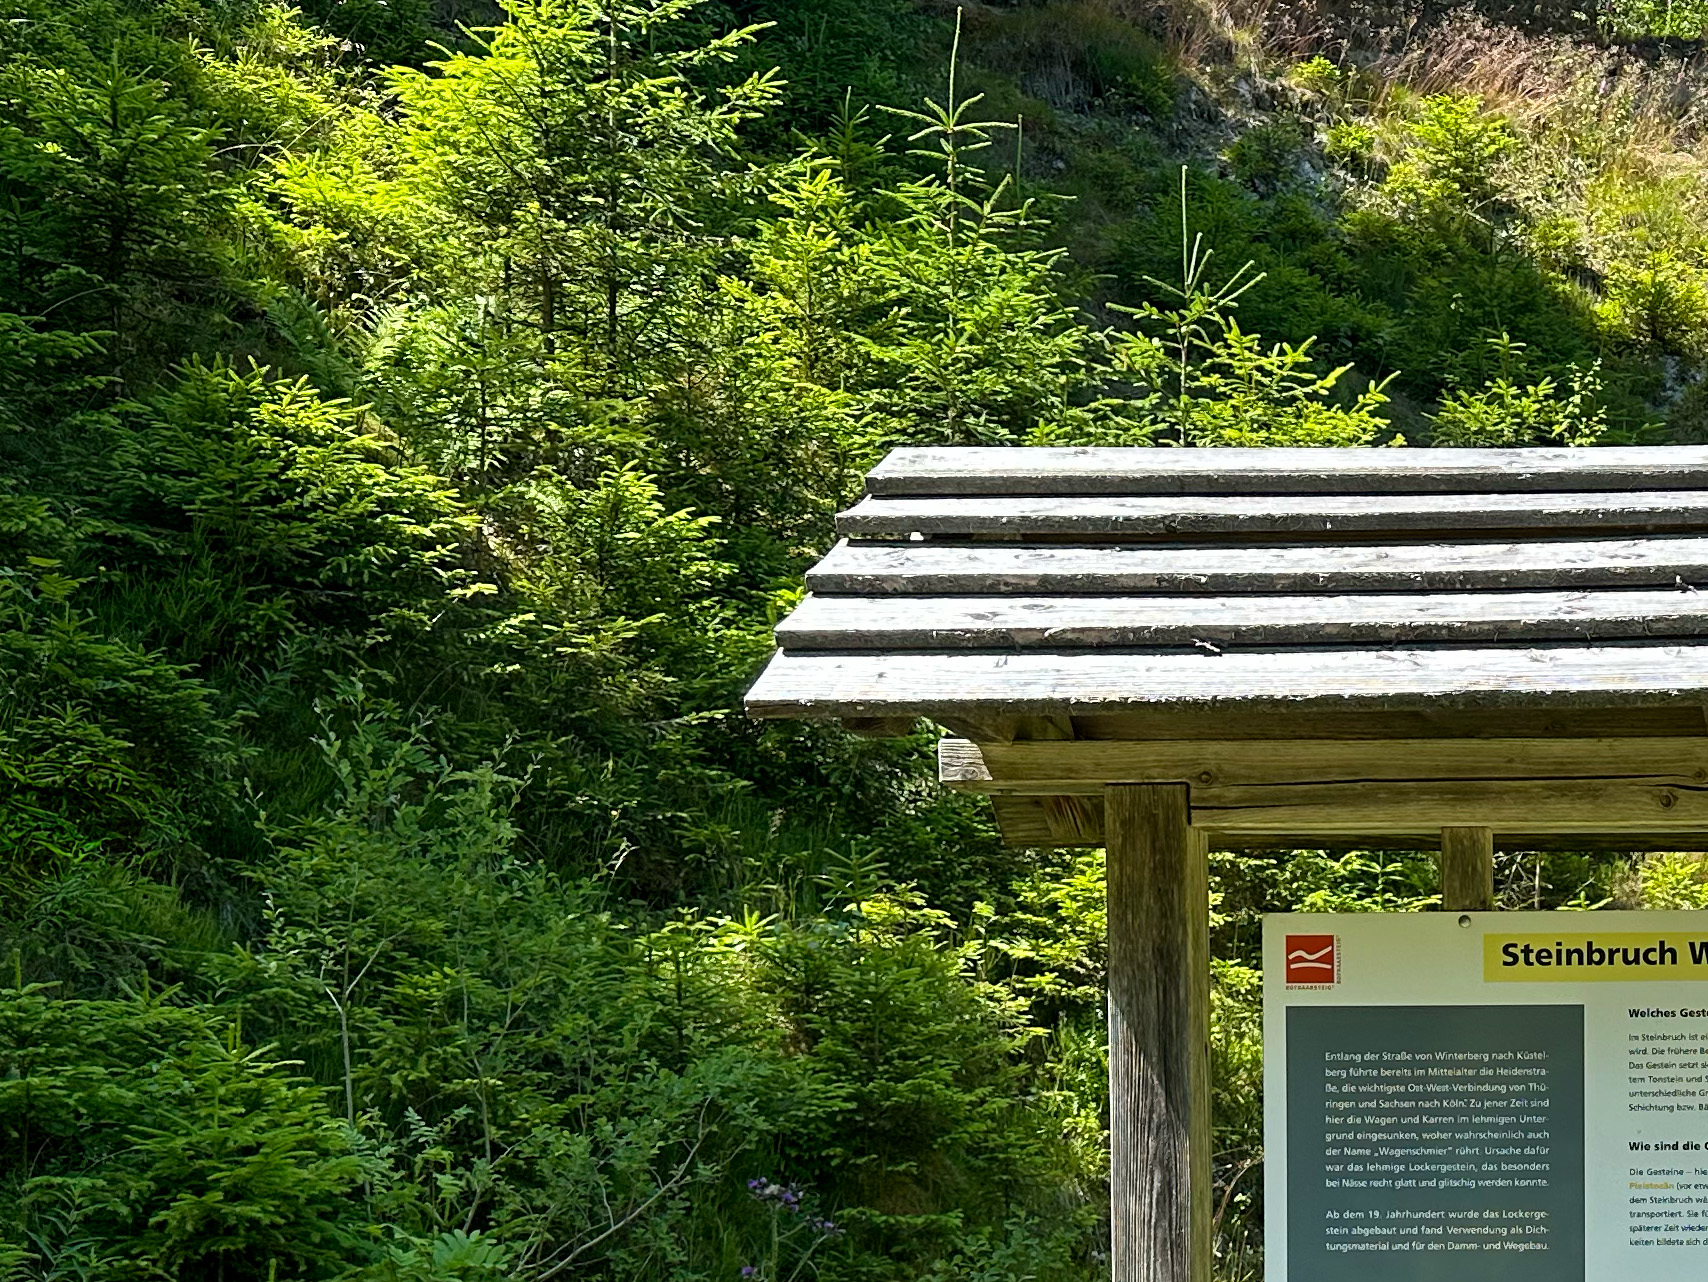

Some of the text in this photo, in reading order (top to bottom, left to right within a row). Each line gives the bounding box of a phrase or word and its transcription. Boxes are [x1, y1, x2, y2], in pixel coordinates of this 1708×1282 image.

[1503, 941, 1677, 966] Steinbruch
[1629, 1008, 1676, 1017] Welches
[1326, 1052, 1361, 1062] Entlang
[1364, 1052, 1379, 1060] der
[1383, 1052, 1412, 1060] Straße
[1435, 1052, 1489, 1062] Winterberg
[1492, 1051, 1514, 1059] nach
[1517, 1051, 1550, 1059] Küstel-
[1325, 1068, 1346, 1078] berg
[1349, 1068, 1378, 1076] führte
[1381, 1068, 1411, 1076] bereits
[1480, 1067, 1493, 1075] die
[1497, 1067, 1550, 1075] Heidenstra-
[1342, 1084, 1356, 1092] die
[1359, 1084, 1405, 1094] wichtigste
[1408, 1083, 1506, 1093] Ost-West-Verbindung
[1529, 1083, 1550, 1091] Thü-
[1326, 1100, 1355, 1110] ringen
[1359, 1099, 1376, 1108] und
[1379, 1099, 1415, 1108] Sachsen
[1418, 1099, 1440, 1107] nach
[1470, 1099, 1481, 1107] Zu
[1484, 1100, 1507, 1109] jener
[1510, 1099, 1528, 1107] Zeit
[1531, 1099, 1549, 1107] sind
[1326, 1116, 1344, 1124] hier
[1347, 1115, 1361, 1124] die
[1364, 1116, 1397, 1126] Wagen
[1401, 1115, 1419, 1123] und
[1423, 1115, 1454, 1123] Karren
[1472, 1114, 1516, 1125] lehmigen
[1520, 1115, 1550, 1123] Unter-
[1326, 1130, 1549, 1142] grund eingesunken, woher wahrscheinlich auch
[1326, 1147, 1341, 1155] der
[1344, 1147, 1371, 1155] Name
[1485, 1146, 1521, 1154] Ursache
[1524, 1146, 1549, 1154] dafür
[1629, 1142, 1650, 1151] Wie
[1655, 1141, 1678, 1150] sind
[1683, 1141, 1700, 1150] die
[1347, 1163, 1363, 1171] das
[1367, 1163, 1405, 1173] lehmige
[1409, 1163, 1477, 1173] Lockergestein,
[1482, 1162, 1497, 1170] das
[1501, 1162, 1549, 1170] besonders
[1326, 1179, 1339, 1187] bei
[1370, 1179, 1392, 1187] recht
[1395, 1179, 1416, 1189] glatt
[1419, 1178, 1436, 1186] und
[1439, 1178, 1475, 1189] glitschig
[1478, 1178, 1512, 1186] werden
[1515, 1178, 1550, 1186] konnte.
[1343, 1210, 1364, 1218] dem
[1386, 1210, 1445, 1218] Jahrhundert
[1449, 1210, 1479, 1218] wurde
[1483, 1210, 1499, 1218] das
[1503, 1210, 1550, 1220] Lockerge-
[1352, 1226, 1396, 1236] abgebaut
[1400, 1226, 1418, 1234] und
[1421, 1225, 1442, 1235] fand
[1447, 1225, 1507, 1236] Verwendung
[1526, 1225, 1550, 1233] Dich-
[1326, 1241, 1550, 1252] tungsmaterial und für den Damm- und Wegebau.
